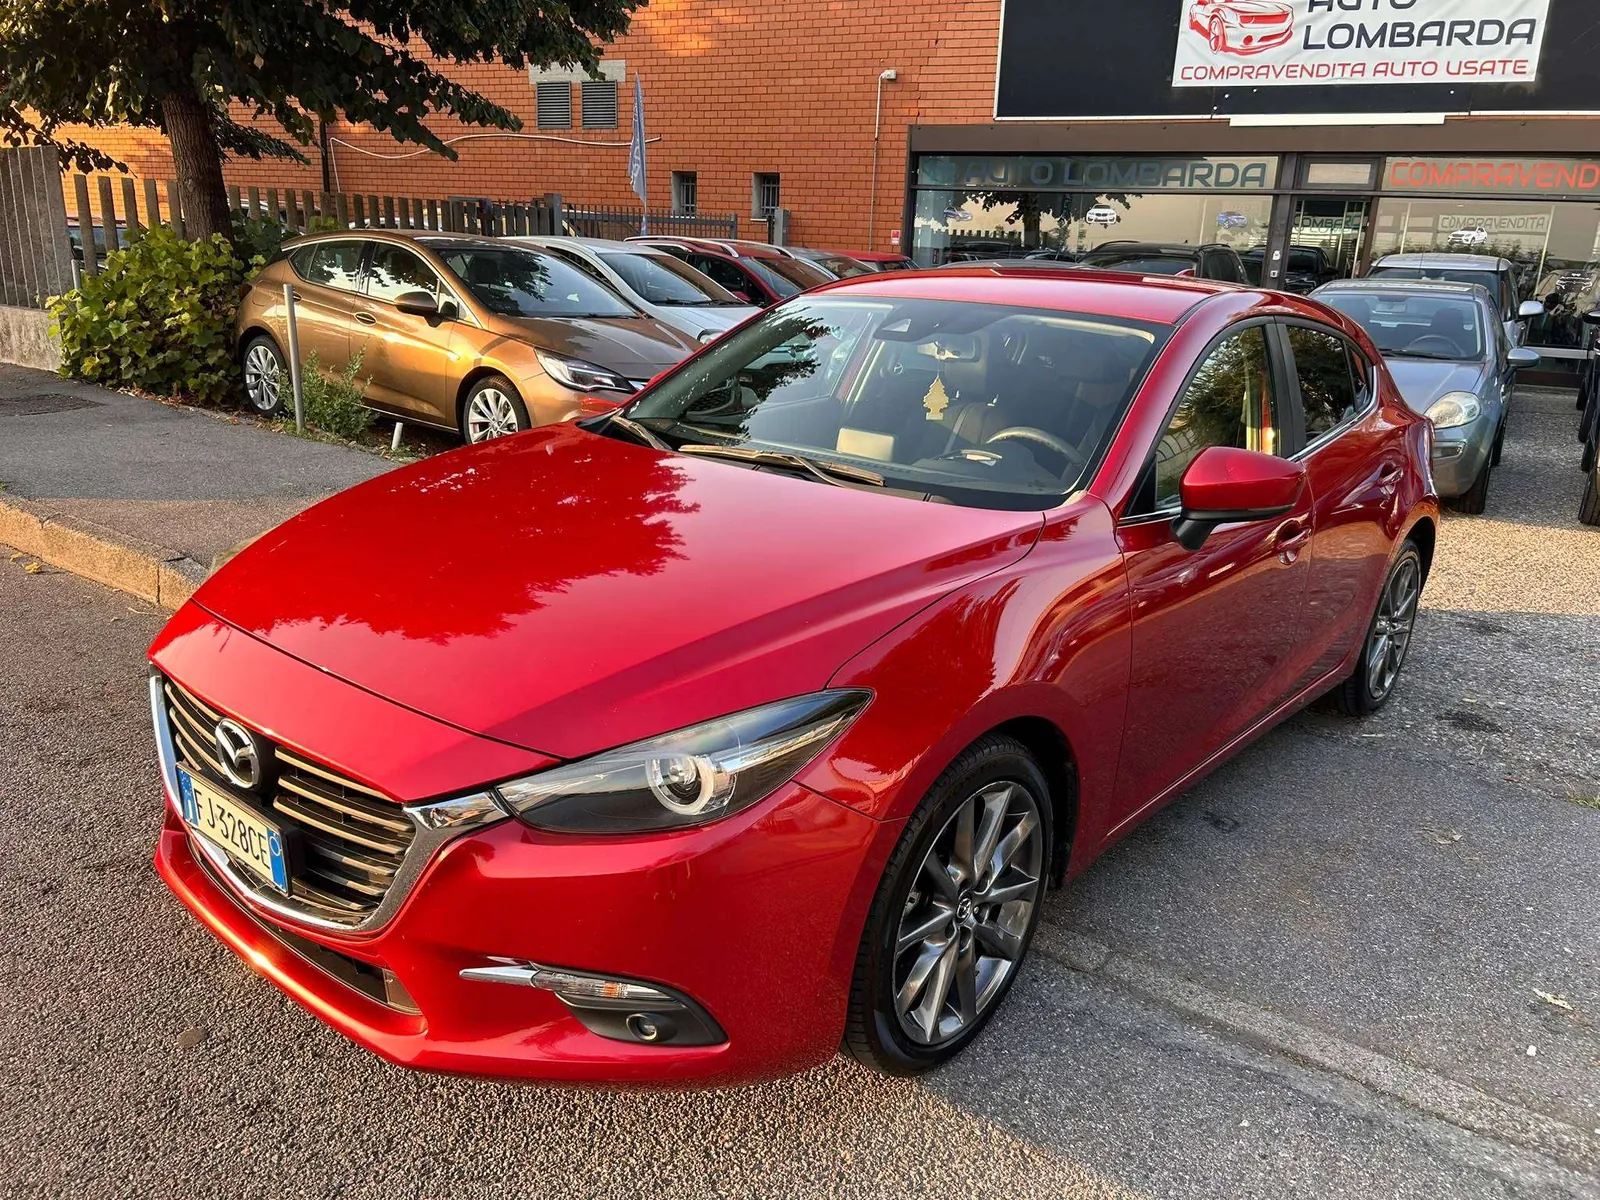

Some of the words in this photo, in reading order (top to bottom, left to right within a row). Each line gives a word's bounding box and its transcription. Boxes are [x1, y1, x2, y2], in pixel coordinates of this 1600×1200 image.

[1303, 18, 1536, 50] LOMBARDA
[1181, 62, 1366, 81] COMPRAVENDITA
[1373, 61, 1438, 77] AUTO
[1446, 59, 1529, 76] USATE
[965, 161, 1054, 185] AUTO
[1063, 162, 1267, 188] LOMBARDA
[1390, 161, 1599, 188] COMPRAVEND
[1441, 216, 1546, 230] COMPRAVENDITA
[193, 787, 271, 870] FJ328CE
